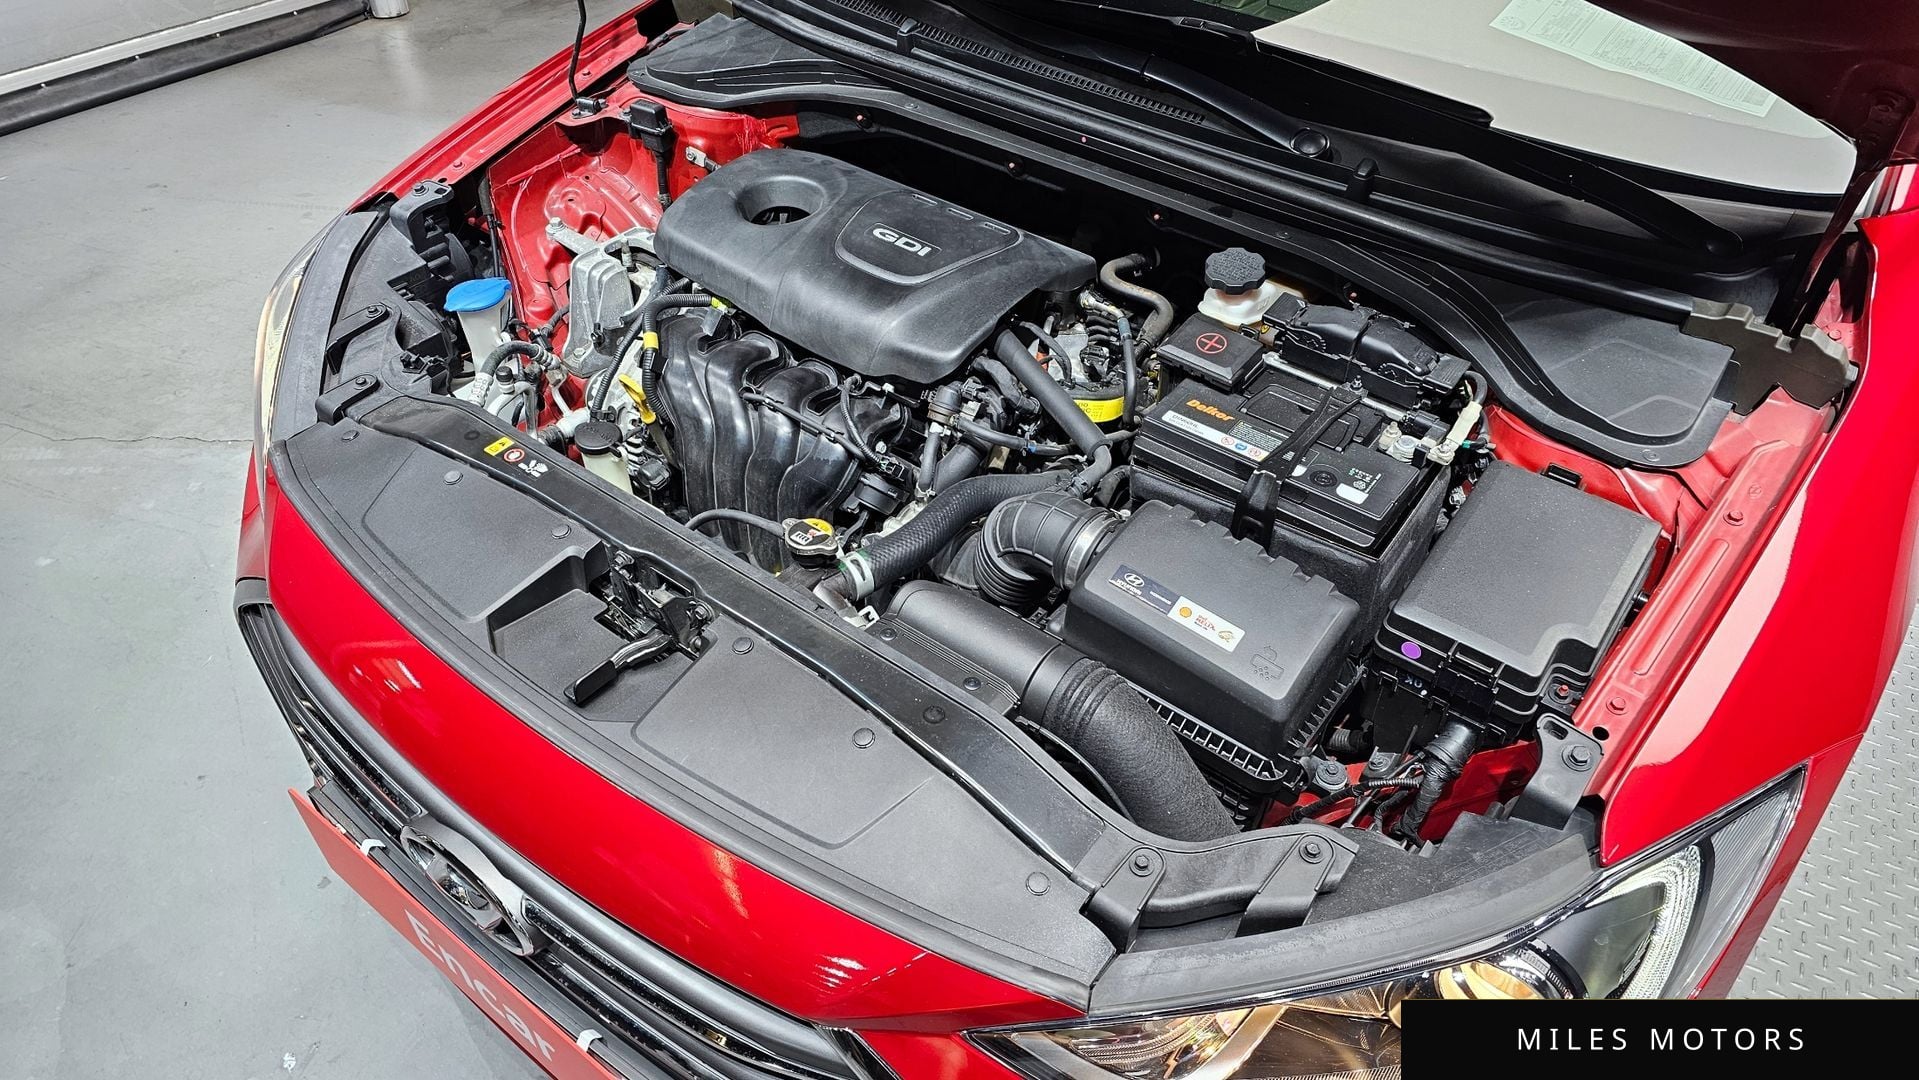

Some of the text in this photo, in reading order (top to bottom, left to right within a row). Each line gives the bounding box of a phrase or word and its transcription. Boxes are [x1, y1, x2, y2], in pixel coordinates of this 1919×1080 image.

[873, 228, 932, 257] GDI
[1186, 399, 1235, 422] Delkor
[1115, 579, 1142, 596] HYUNDAI
[404, 908, 556, 1063] Encar
